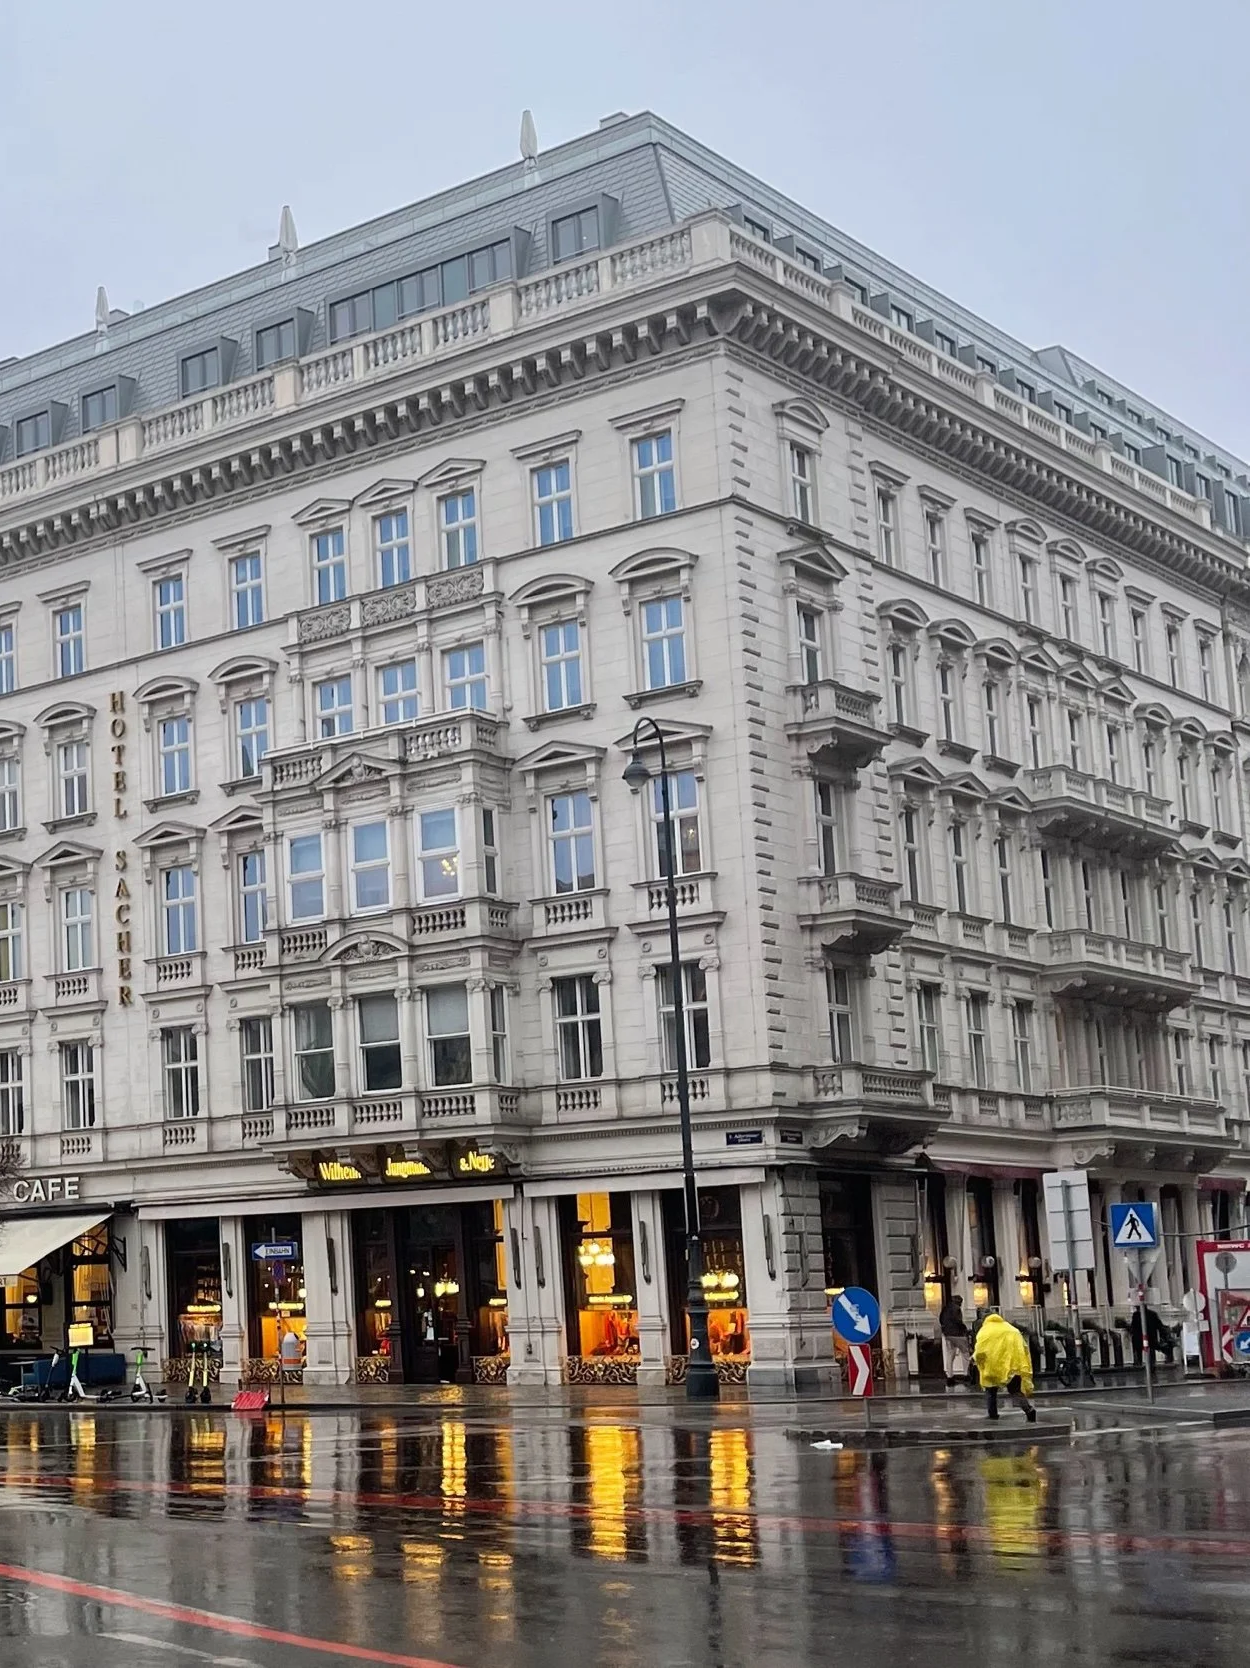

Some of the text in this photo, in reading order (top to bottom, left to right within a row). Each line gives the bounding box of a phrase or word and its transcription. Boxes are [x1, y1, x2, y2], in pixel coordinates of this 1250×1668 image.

[109, 691, 132, 1006] HOTEL SACHER
[13, 1176, 80, 1203] CAFE
